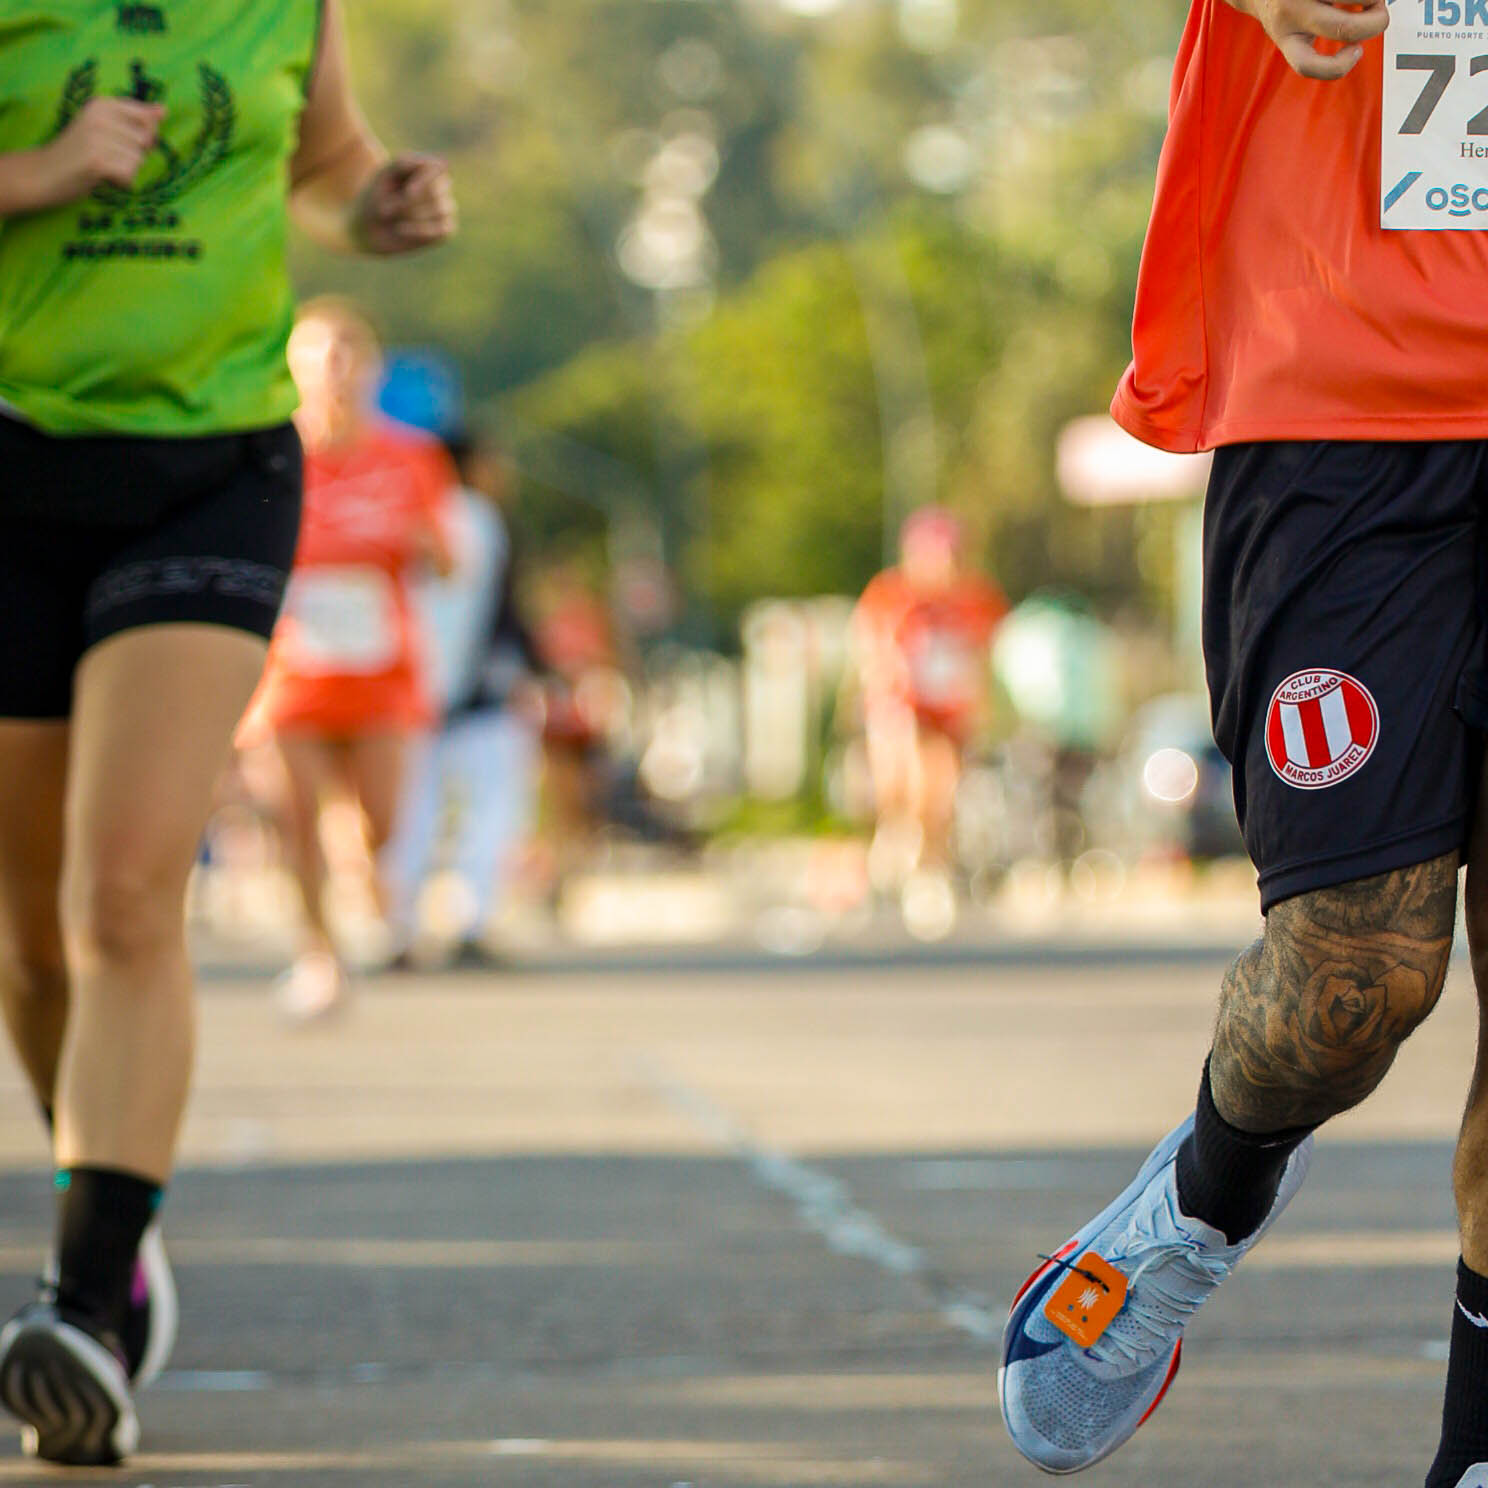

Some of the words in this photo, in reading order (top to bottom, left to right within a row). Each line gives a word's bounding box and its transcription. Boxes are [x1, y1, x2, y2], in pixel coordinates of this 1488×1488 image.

[1416, 31, 1451, 40] PUERTO
[1455, 31, 1484, 40] NORTE
[1279, 676, 1338, 701] ARGENTINO
[1290, 675, 1321, 690] CLUB
[1284, 764, 1324, 782] MARCOS
[1326, 746, 1364, 779] JUAREZ
